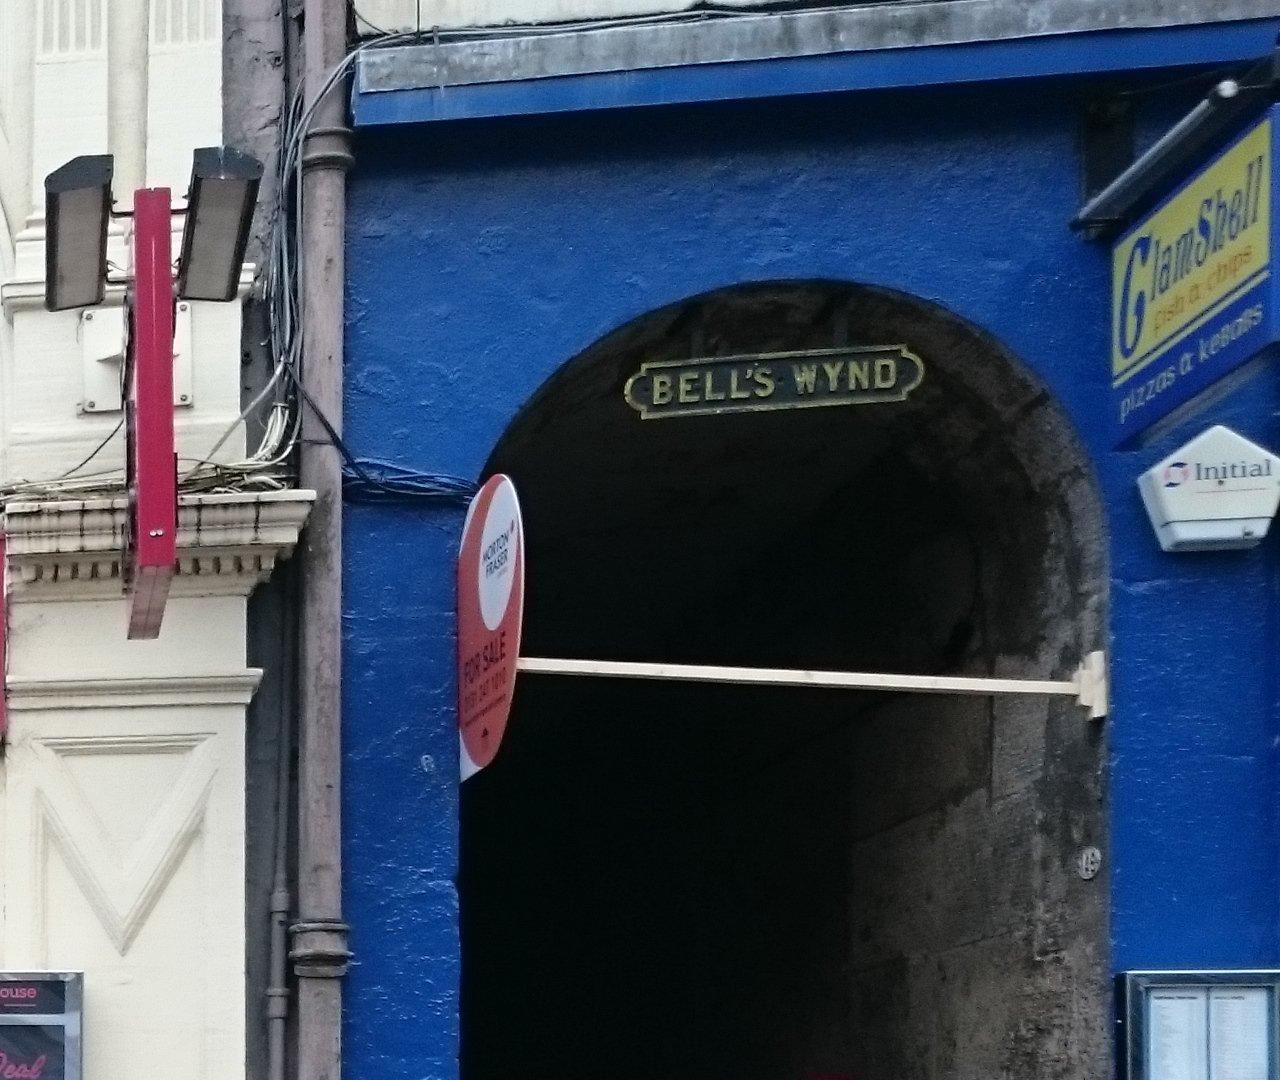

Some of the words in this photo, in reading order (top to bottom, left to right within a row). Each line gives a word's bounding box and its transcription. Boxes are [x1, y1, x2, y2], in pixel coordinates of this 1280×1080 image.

[1120, 155, 1264, 359] ClamShell
[652, 366, 776, 405] BELL'S
[793, 358, 897, 395] WYND
[1120, 365, 1176, 425] pizzas
[1198, 303, 1263, 362] kebabs
[1195, 458, 1273, 481] Initial
[464, 651, 481, 689] FOR
[483, 630, 506, 671] SALE
